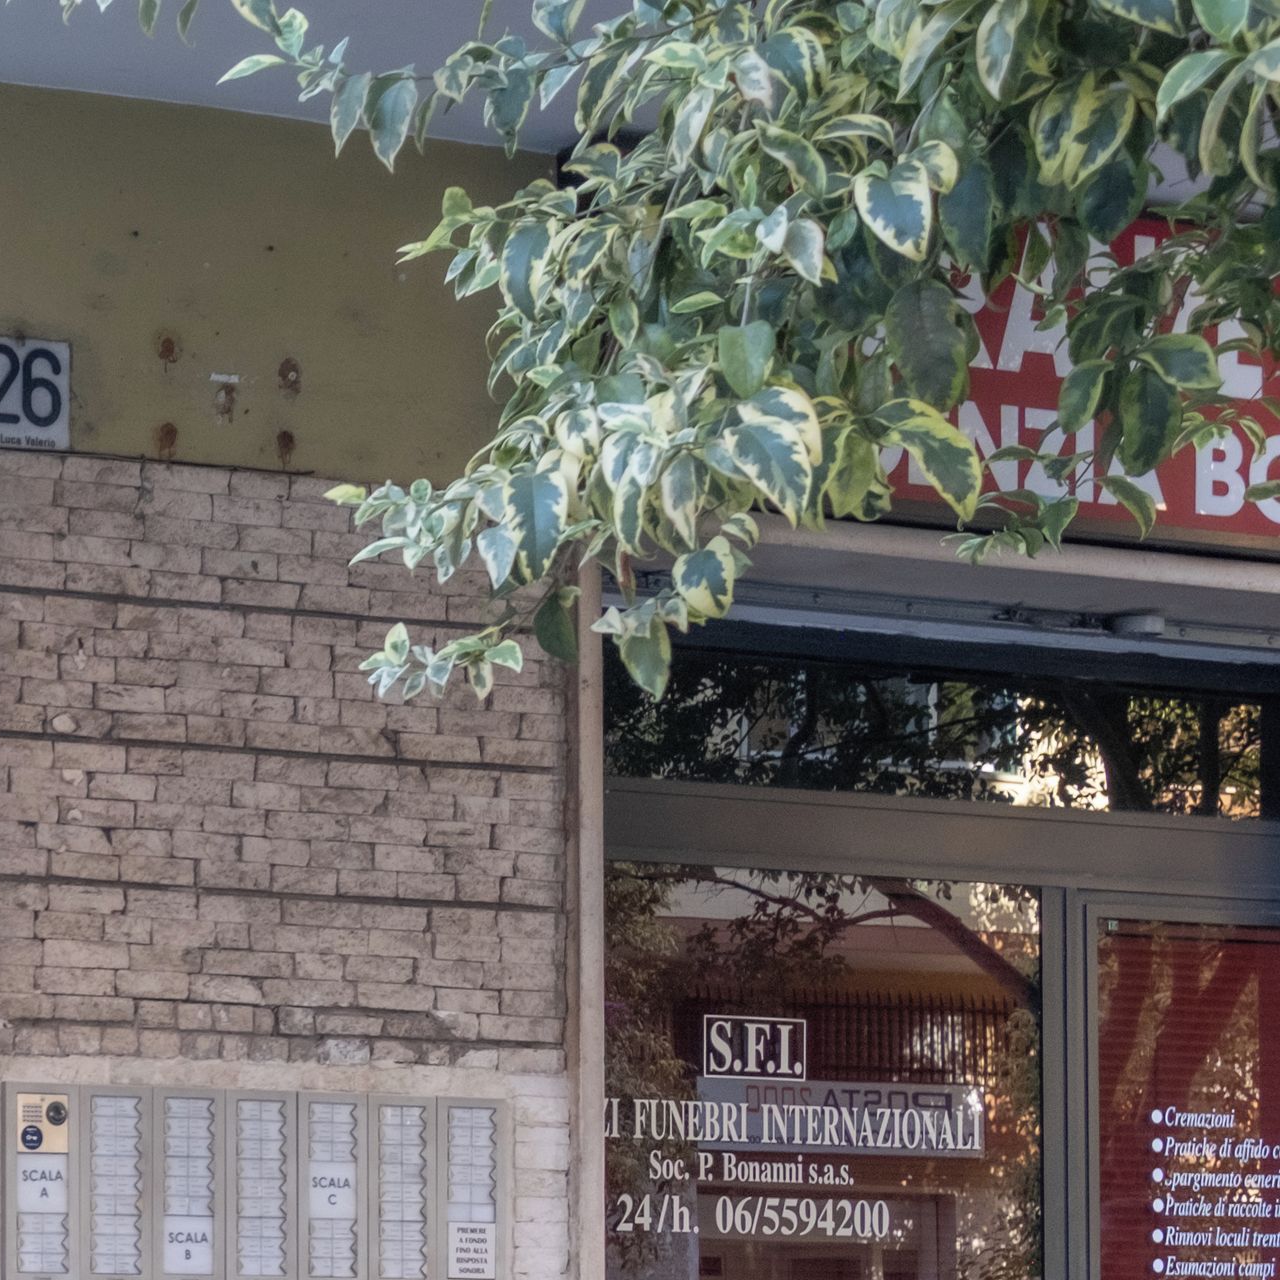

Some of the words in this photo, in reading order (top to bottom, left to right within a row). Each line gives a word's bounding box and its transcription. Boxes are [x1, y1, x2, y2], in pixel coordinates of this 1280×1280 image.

[0, 433, 21, 445] Luca
[24, 435, 56, 448] Valerio
[709, 1020, 803, 1075] S.F.I.
[633, 1099, 749, 1142] FUNEBRI
[761, 1103, 982, 1150] INTERNAZIONALI
[1165, 1106, 1235, 1129] Cremazioni
[1165, 1136, 1217, 1157] Pratiche
[1219, 1137, 1232, 1158] di
[1234, 1138, 1269, 1163] affido
[22, 1169, 64, 1182] SCALA
[649, 1150, 689, 1180] Soc.
[697, 1152, 713, 1181] P.
[722, 1153, 803, 1183] Bonanni
[809, 1163, 854, 1186] s.a.s.
[40, 1187, 49, 1198] A
[311, 1176, 352, 1189] SCALA
[327, 1194, 338, 1206] C
[1165, 1194, 1212, 1216] Pratiche
[1214, 1197, 1226, 1217] di
[1228, 1198, 1272, 1217] raccolte
[616, 1193, 699, 1234] 24/h.
[715, 1195, 890, 1238] 06/5594200
[168, 1231, 209, 1244] SCALA
[1165, 1226, 1213, 1247] Rinnovi
[1215, 1227, 1250, 1247] loculi
[184, 1249, 192, 1260] B
[456, 1246, 472, 1254] FINO
[1165, 1255, 1236, 1278] Esumazioni
